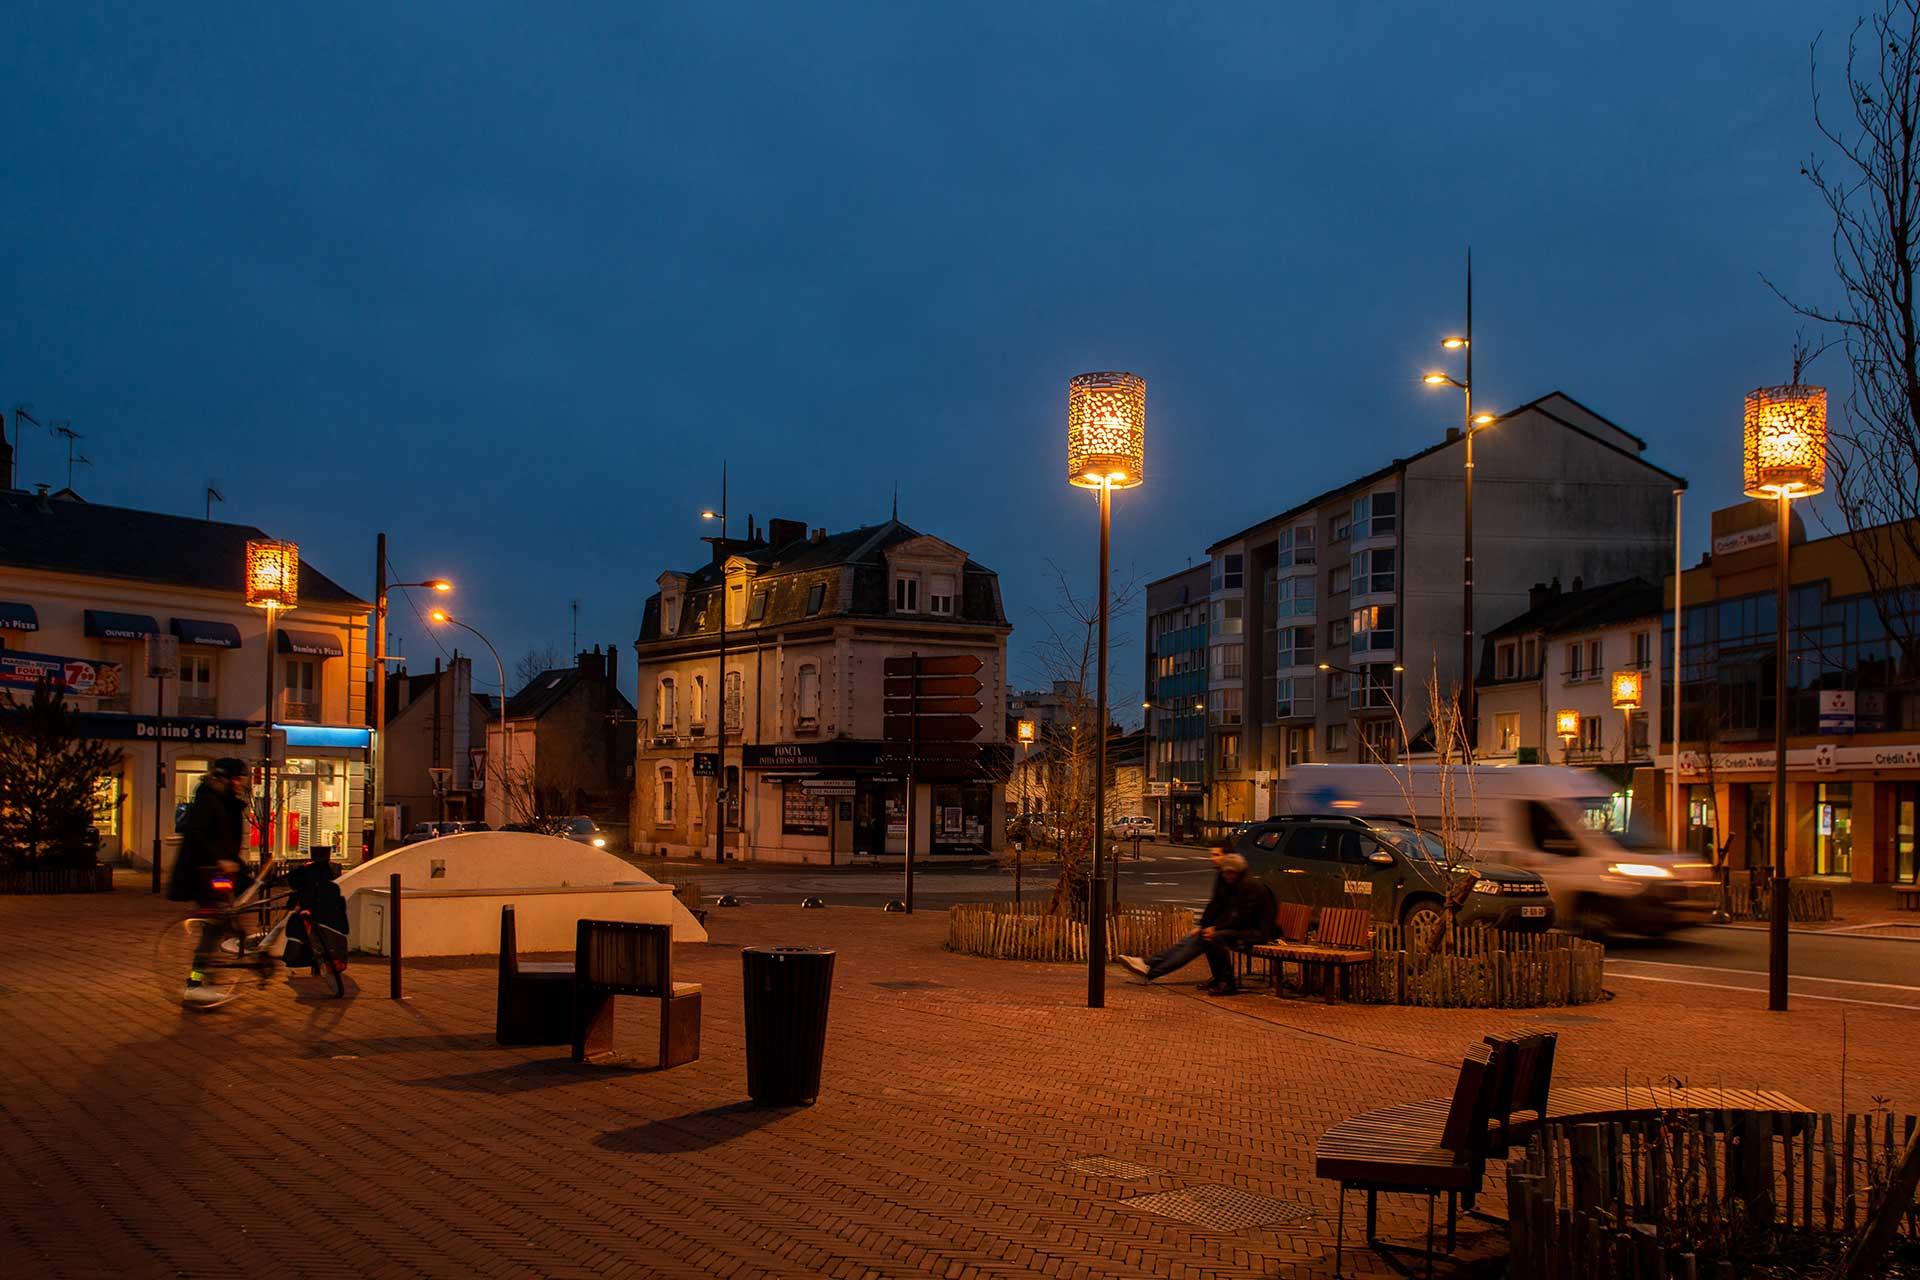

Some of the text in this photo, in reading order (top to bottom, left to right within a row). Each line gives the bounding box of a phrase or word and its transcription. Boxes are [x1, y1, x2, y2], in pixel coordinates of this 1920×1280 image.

[13, 619, 36, 630] Pizza
[105, 629, 135, 638] OUVERT
[136, 721, 243, 740] Domino's Pizza
[775, 745, 801, 757] FONCIA
[1725, 757, 1747, 768] Crédit
[1876, 753, 1904, 765] Crédit
